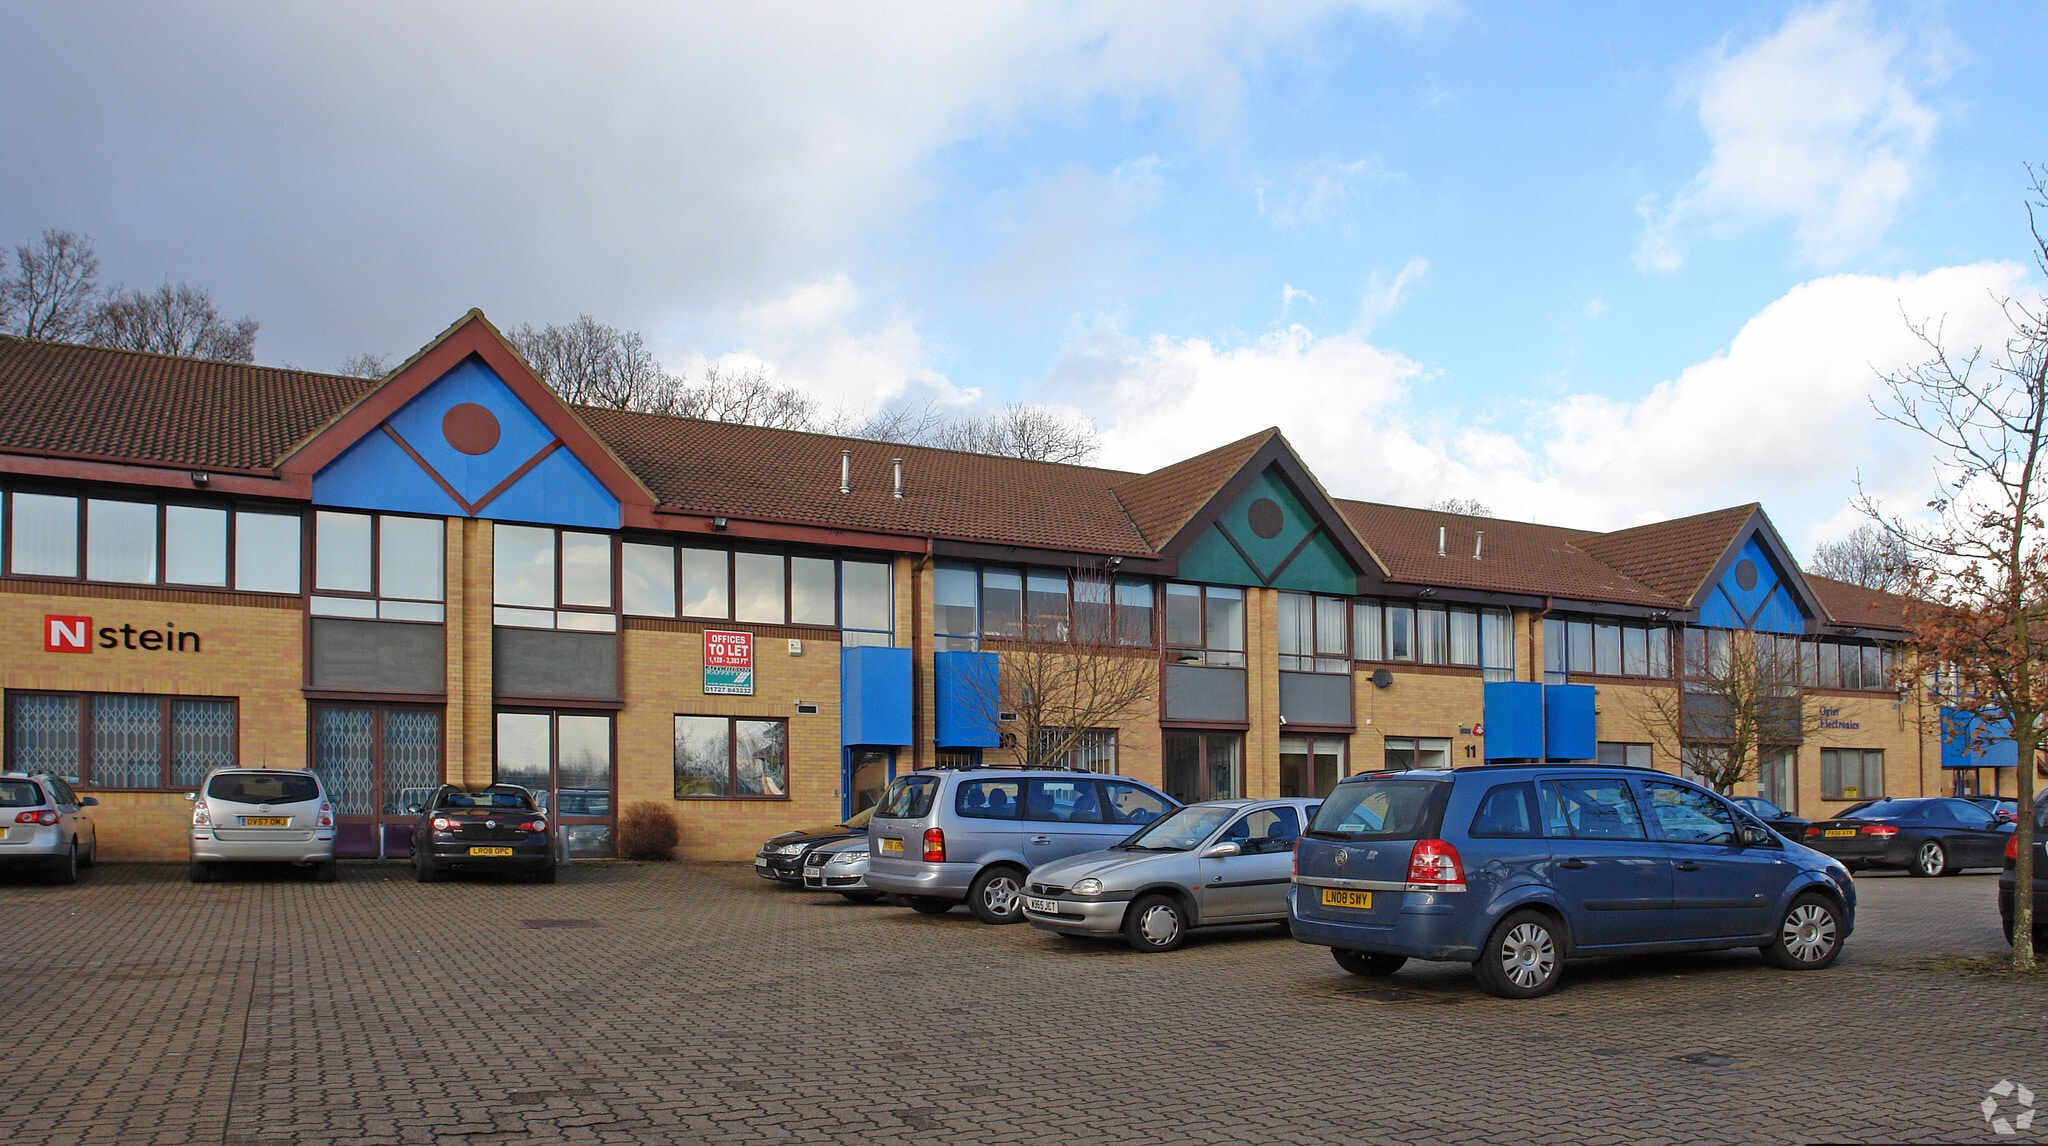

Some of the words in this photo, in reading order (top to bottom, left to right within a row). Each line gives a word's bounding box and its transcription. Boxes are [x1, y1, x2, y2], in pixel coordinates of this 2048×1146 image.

[711, 634, 746, 644] OFFICES
[708, 643, 725, 656] TO
[727, 644, 749, 657] LET
[1820, 719, 1859, 730] Electronics
[1464, 744, 1476, 758] 11
[1326, 890, 1348, 904] LN08
[1349, 892, 1368, 905] SWY
